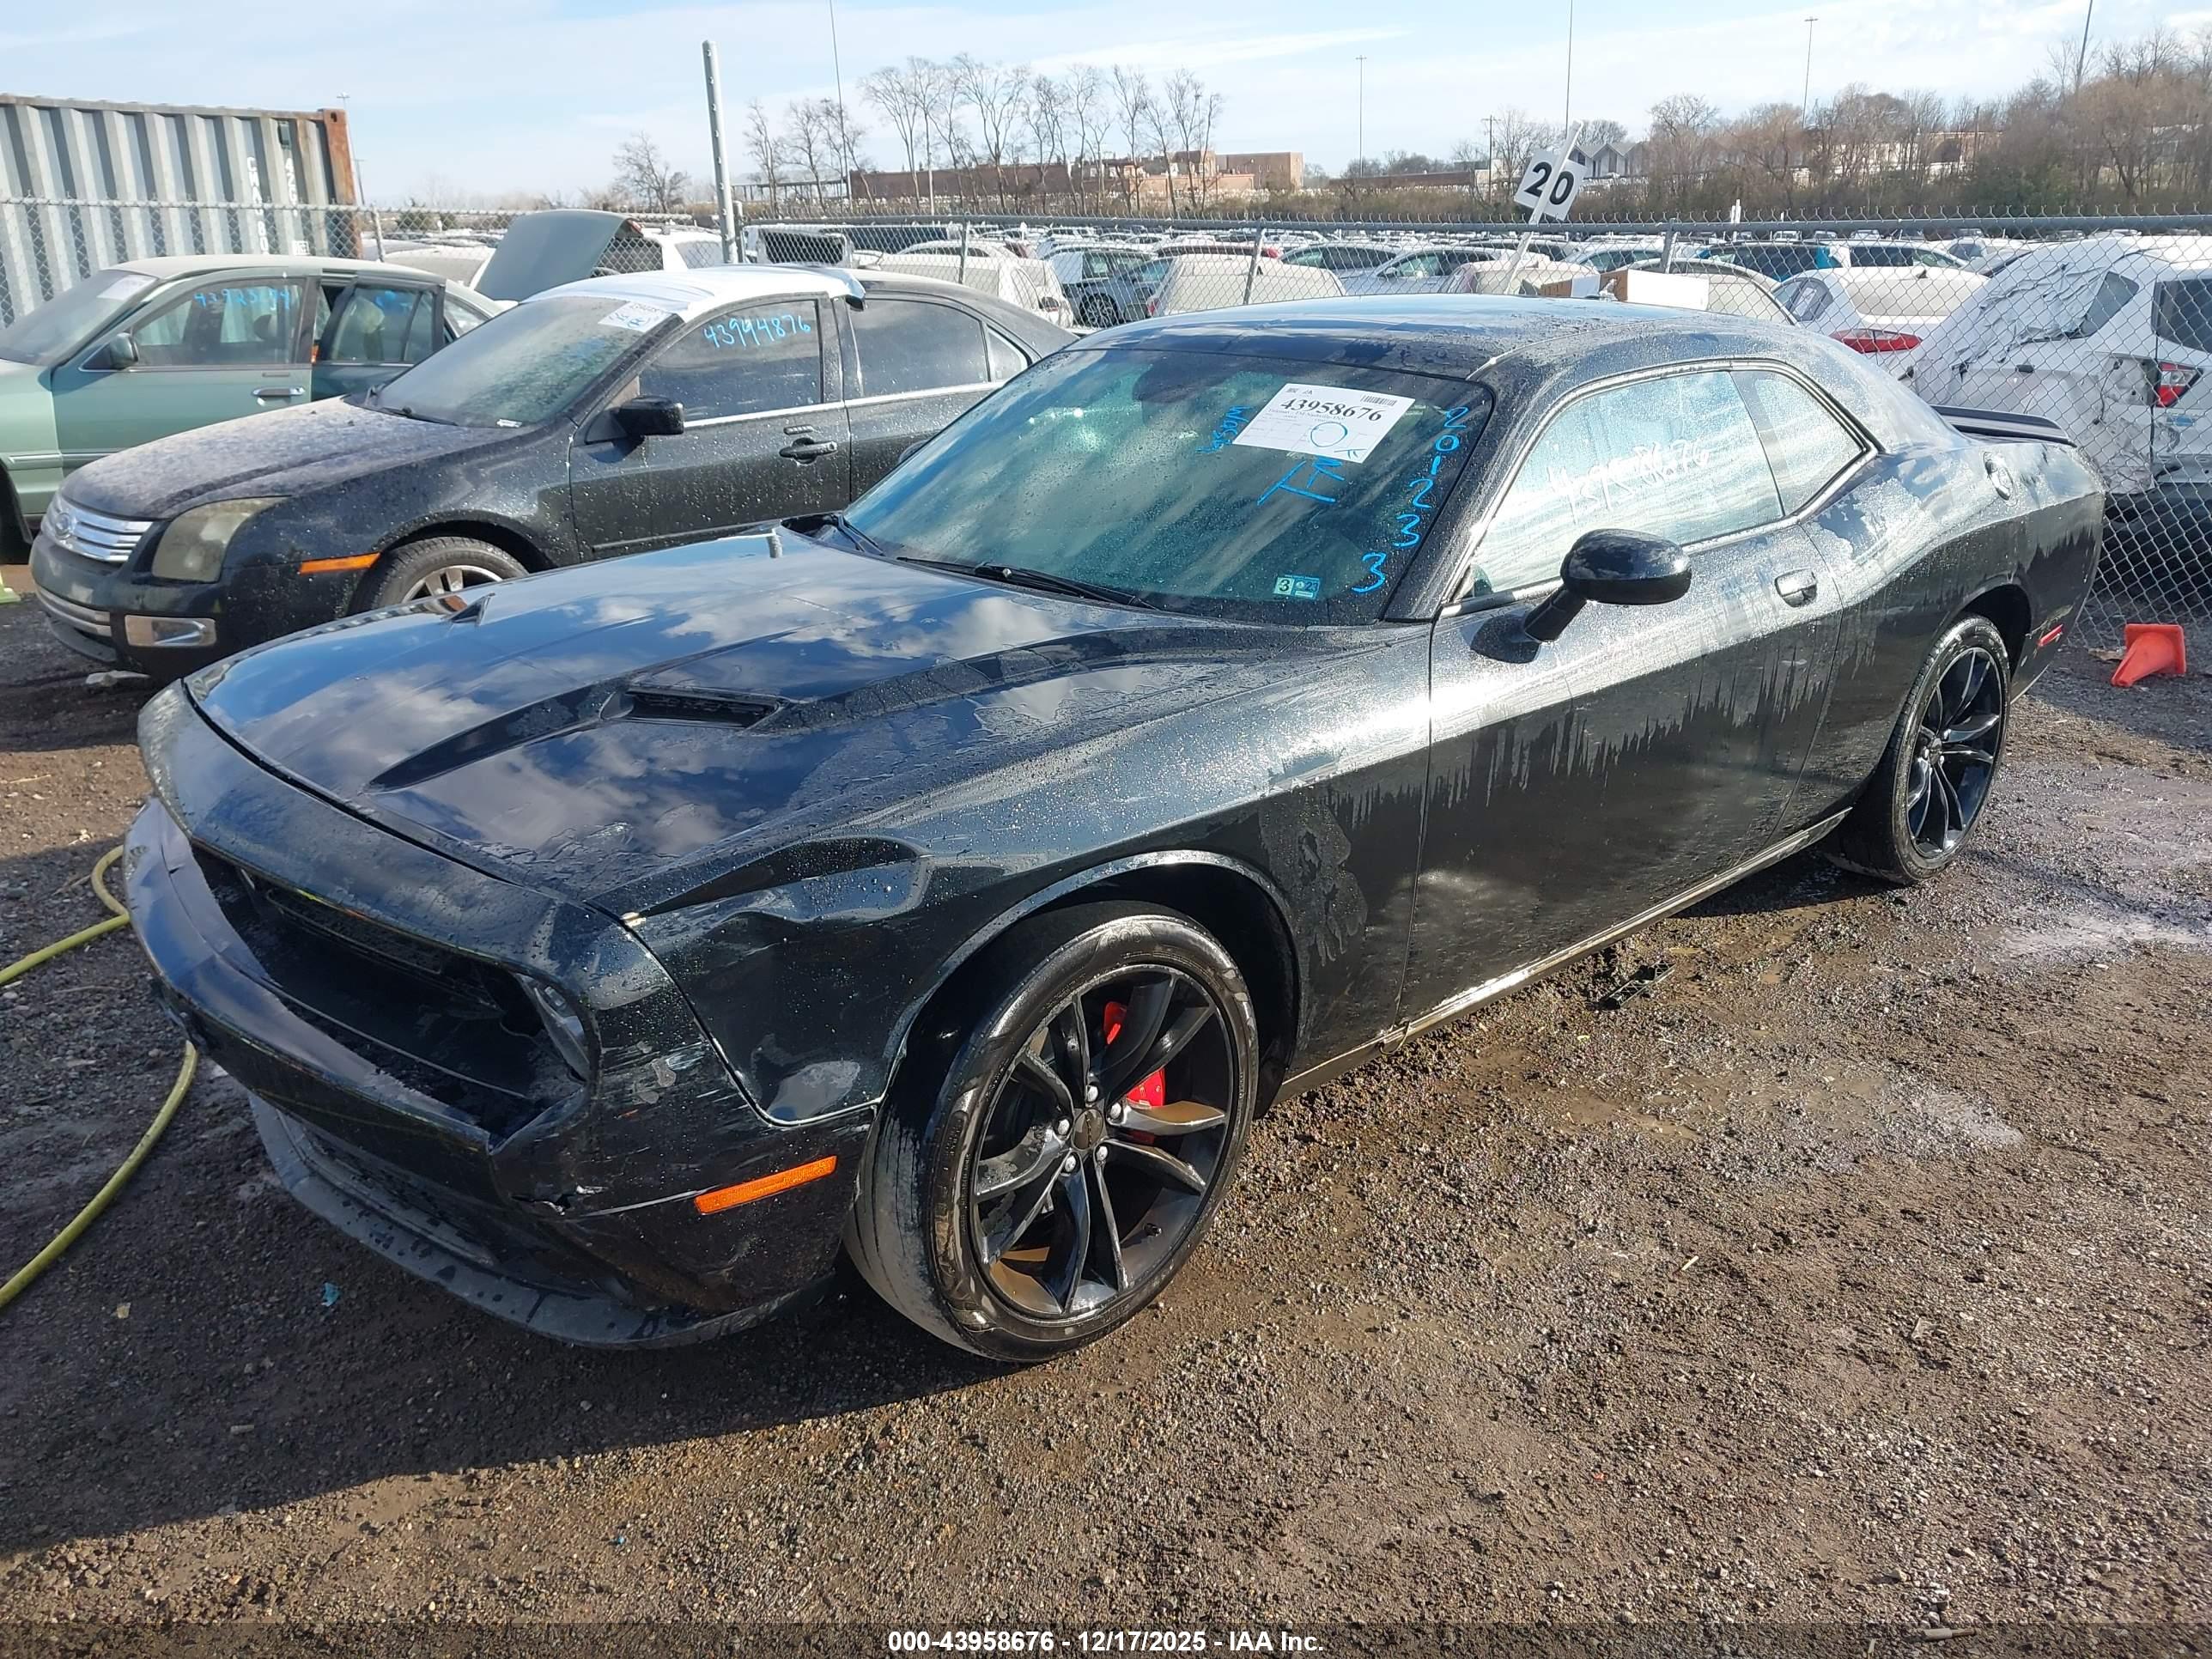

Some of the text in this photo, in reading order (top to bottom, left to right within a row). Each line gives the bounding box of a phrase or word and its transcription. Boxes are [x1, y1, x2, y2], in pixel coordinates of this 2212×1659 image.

[1523, 161, 1575, 205] 20
[1280, 398, 1388, 422] 43958676
[1279, 579, 1291, 592] 3
